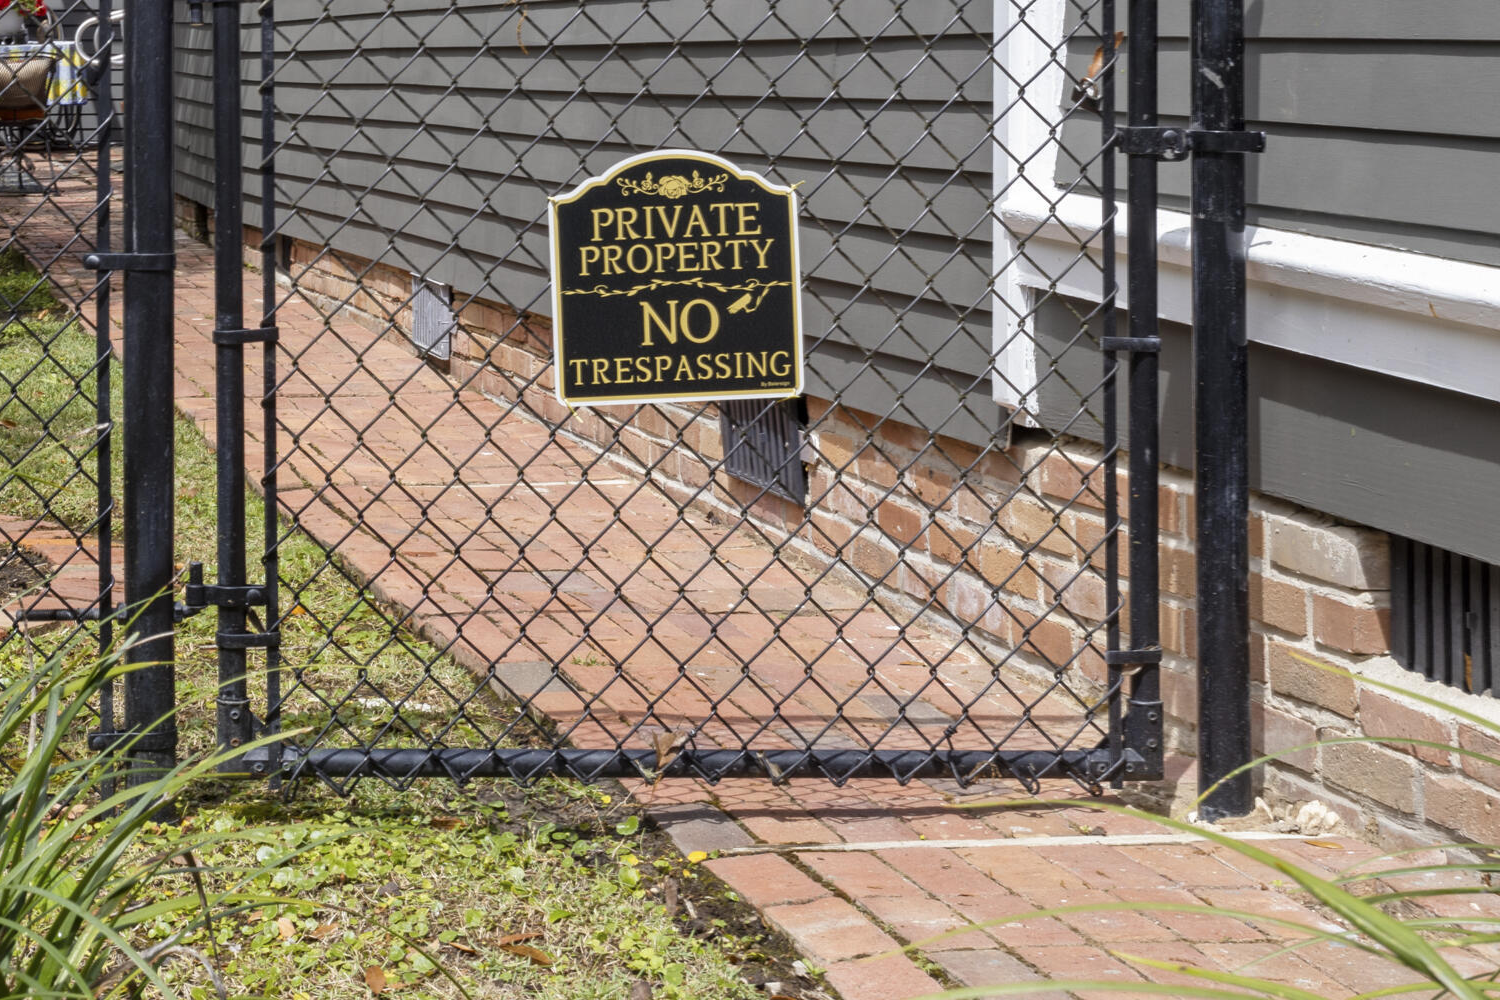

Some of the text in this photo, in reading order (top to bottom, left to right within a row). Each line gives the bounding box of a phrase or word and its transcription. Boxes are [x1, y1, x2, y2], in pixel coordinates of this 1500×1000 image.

[591, 203, 762, 242] PRIVATE
[579, 238, 775, 276] PROPERTY
[639, 299, 720, 346] NO
[569, 351, 792, 386] TRESPASSING
